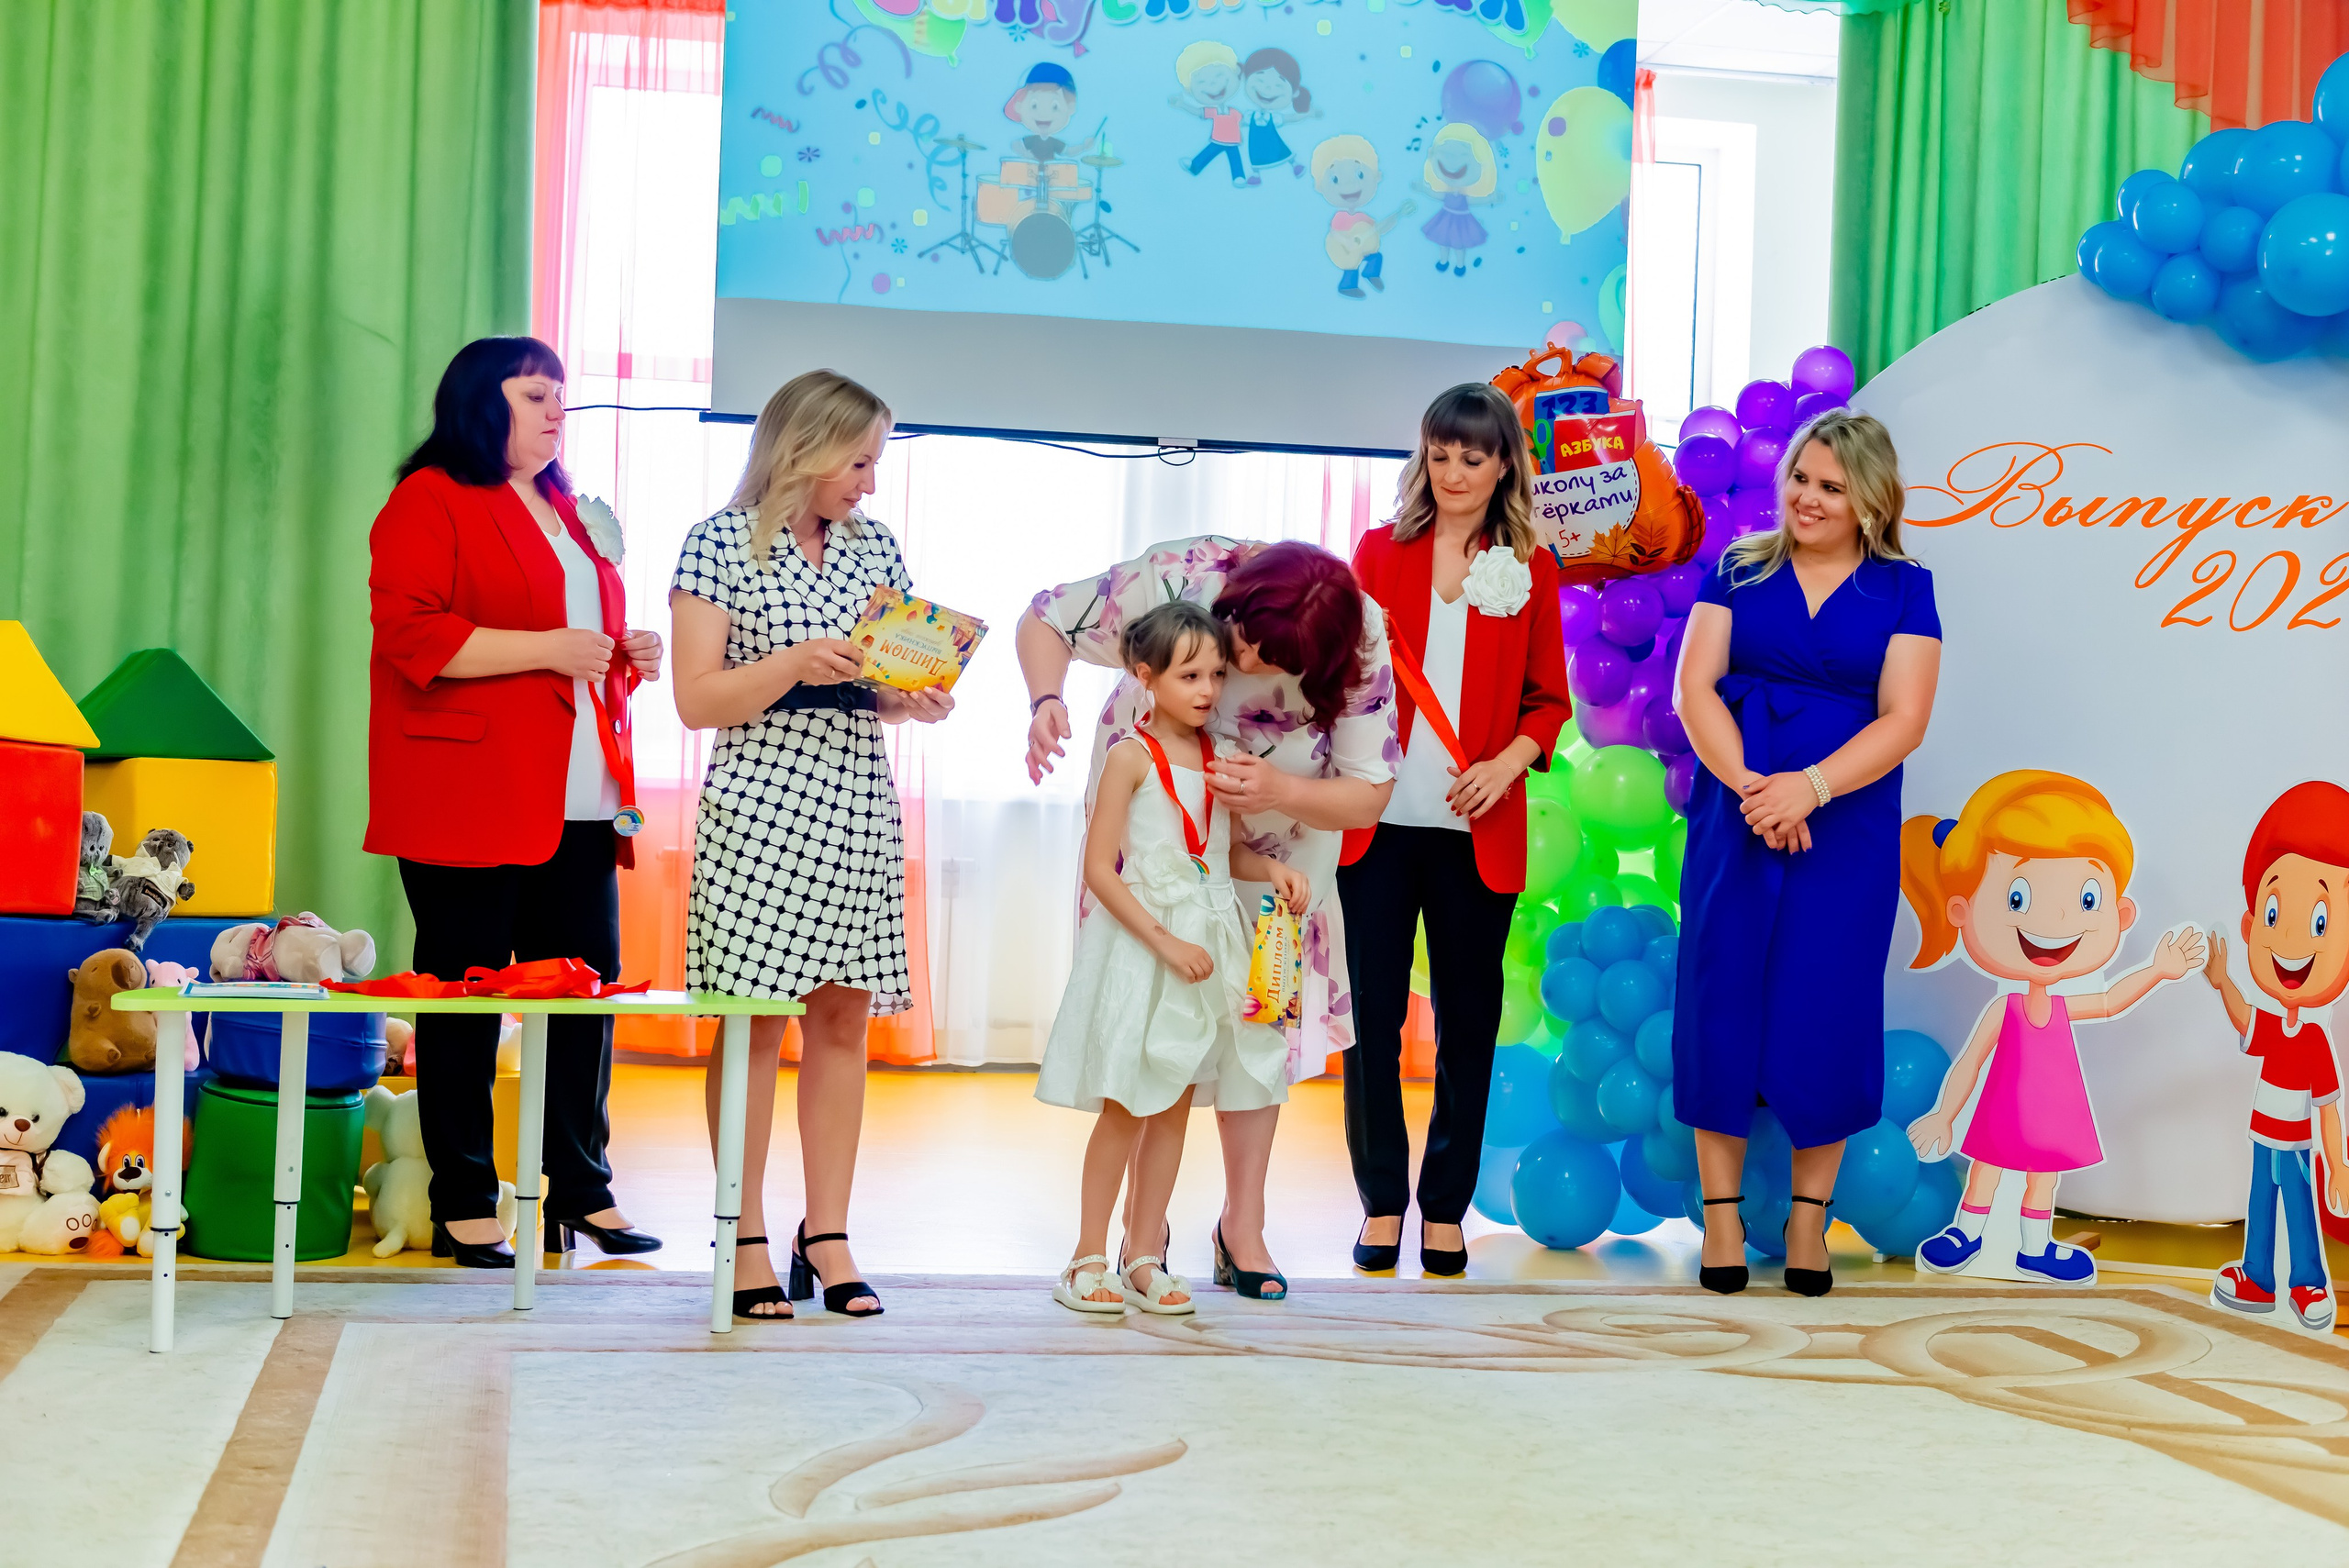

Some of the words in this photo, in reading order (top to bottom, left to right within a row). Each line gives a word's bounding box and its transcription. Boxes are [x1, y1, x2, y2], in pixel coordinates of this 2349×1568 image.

[1542, 393, 1598, 419] 123
[1561, 436, 1625, 458] АЗБУКА
[1599, 466, 1628, 484] за
[1558, 529, 1581, 549] 5+
